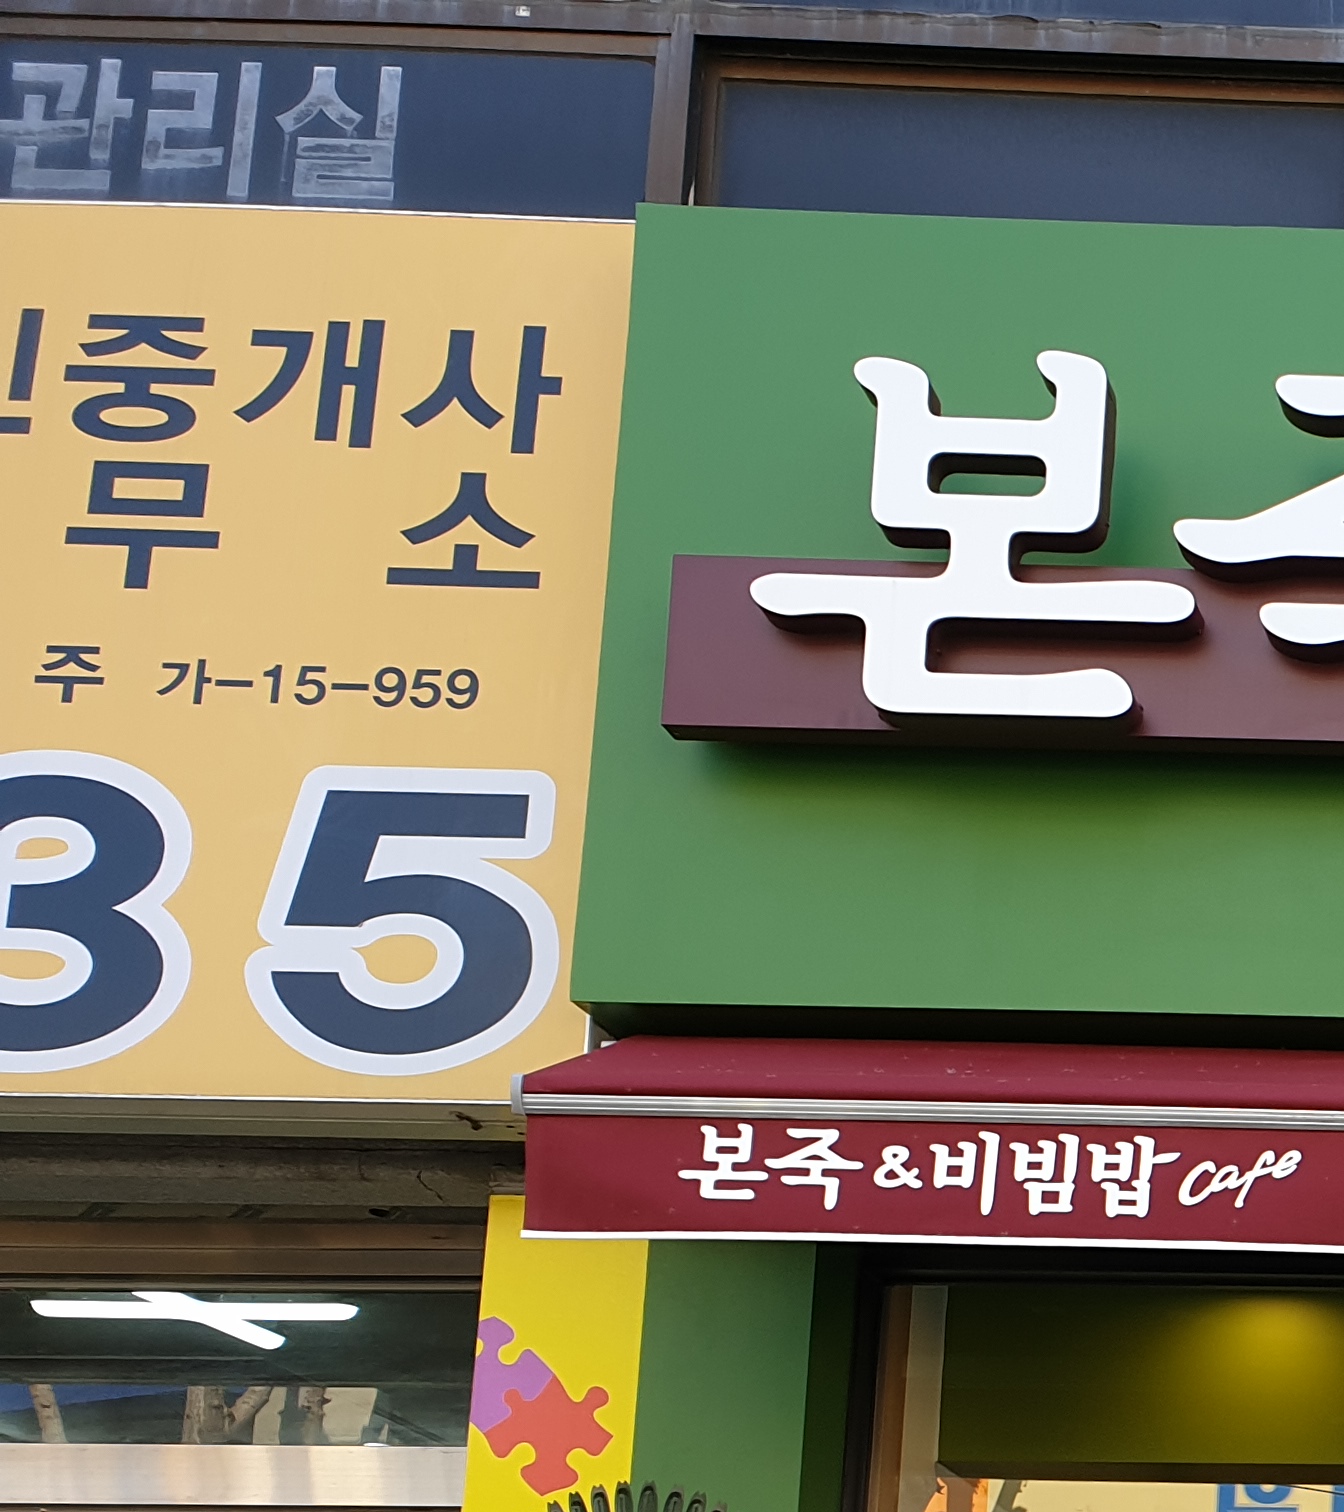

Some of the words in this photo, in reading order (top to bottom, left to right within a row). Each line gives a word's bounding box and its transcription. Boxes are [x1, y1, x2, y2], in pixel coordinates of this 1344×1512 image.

[0, 59, 403, 200] 관리실
[155, 658, 481, 710] 가-15-959
[1178, 1147, 1302, 1208] cafe
